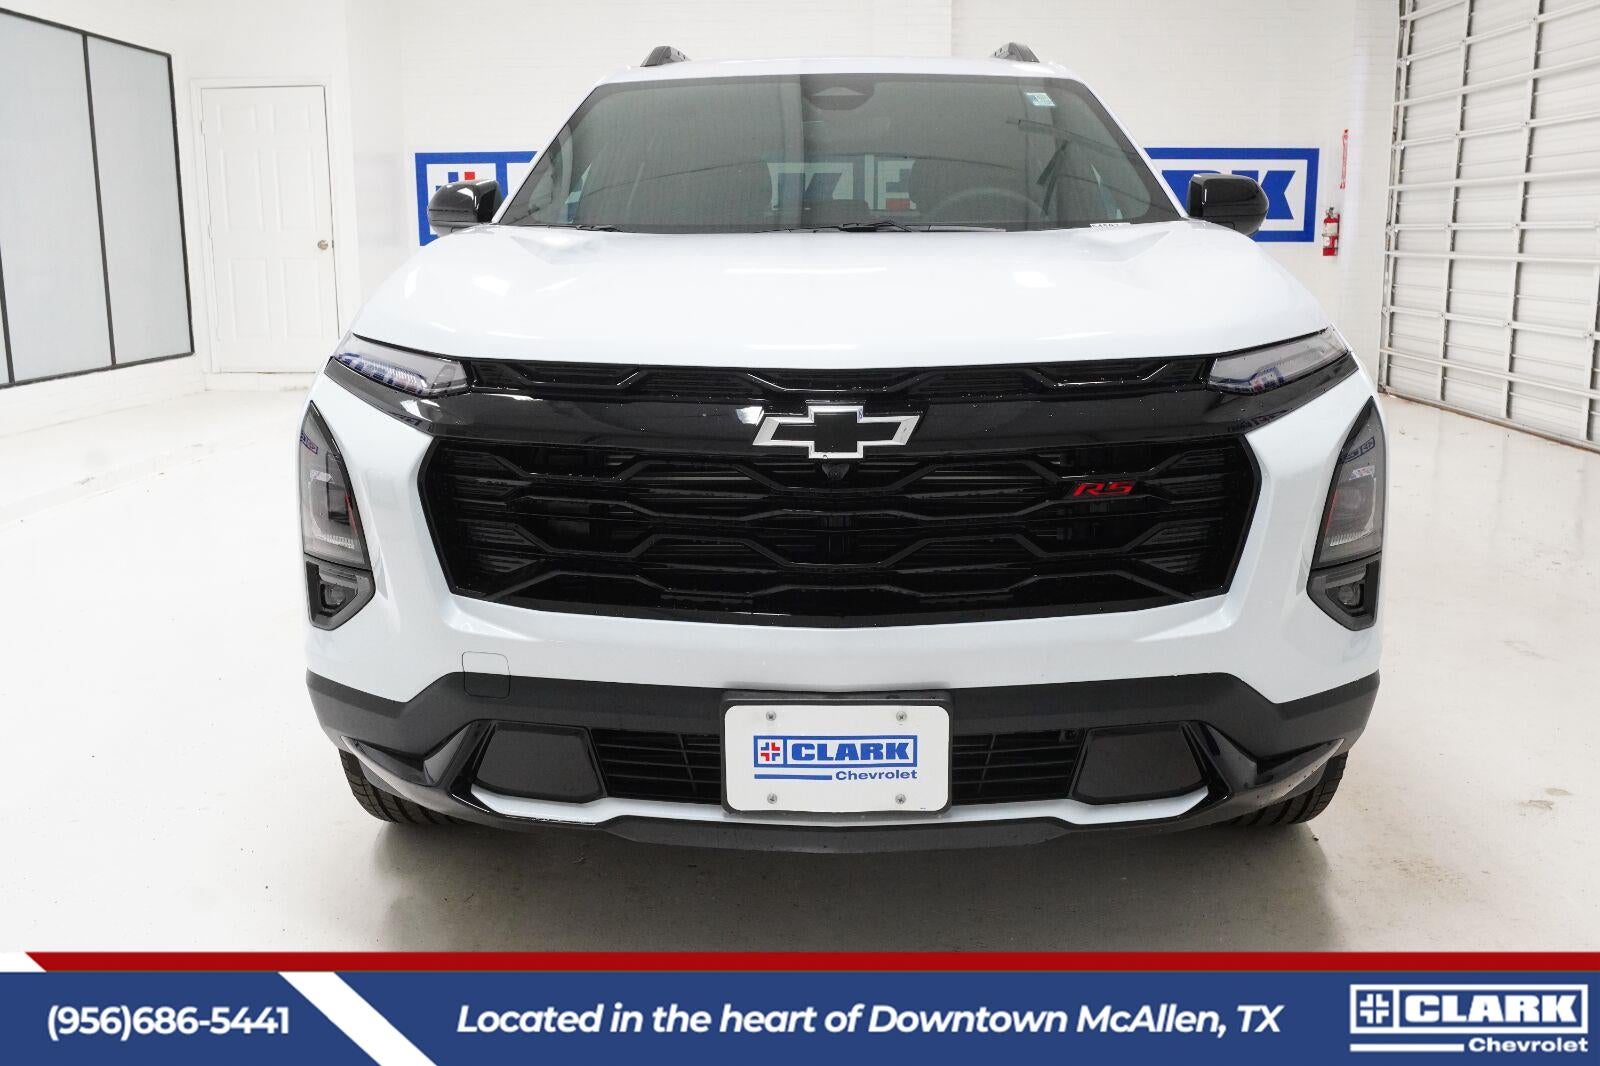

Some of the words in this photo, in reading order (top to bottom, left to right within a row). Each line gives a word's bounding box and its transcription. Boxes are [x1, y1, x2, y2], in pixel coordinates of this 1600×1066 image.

[1072, 481, 1134, 497] RS
[790, 741, 910, 761] CLARK
[835, 769, 918, 781] Chevrolet
